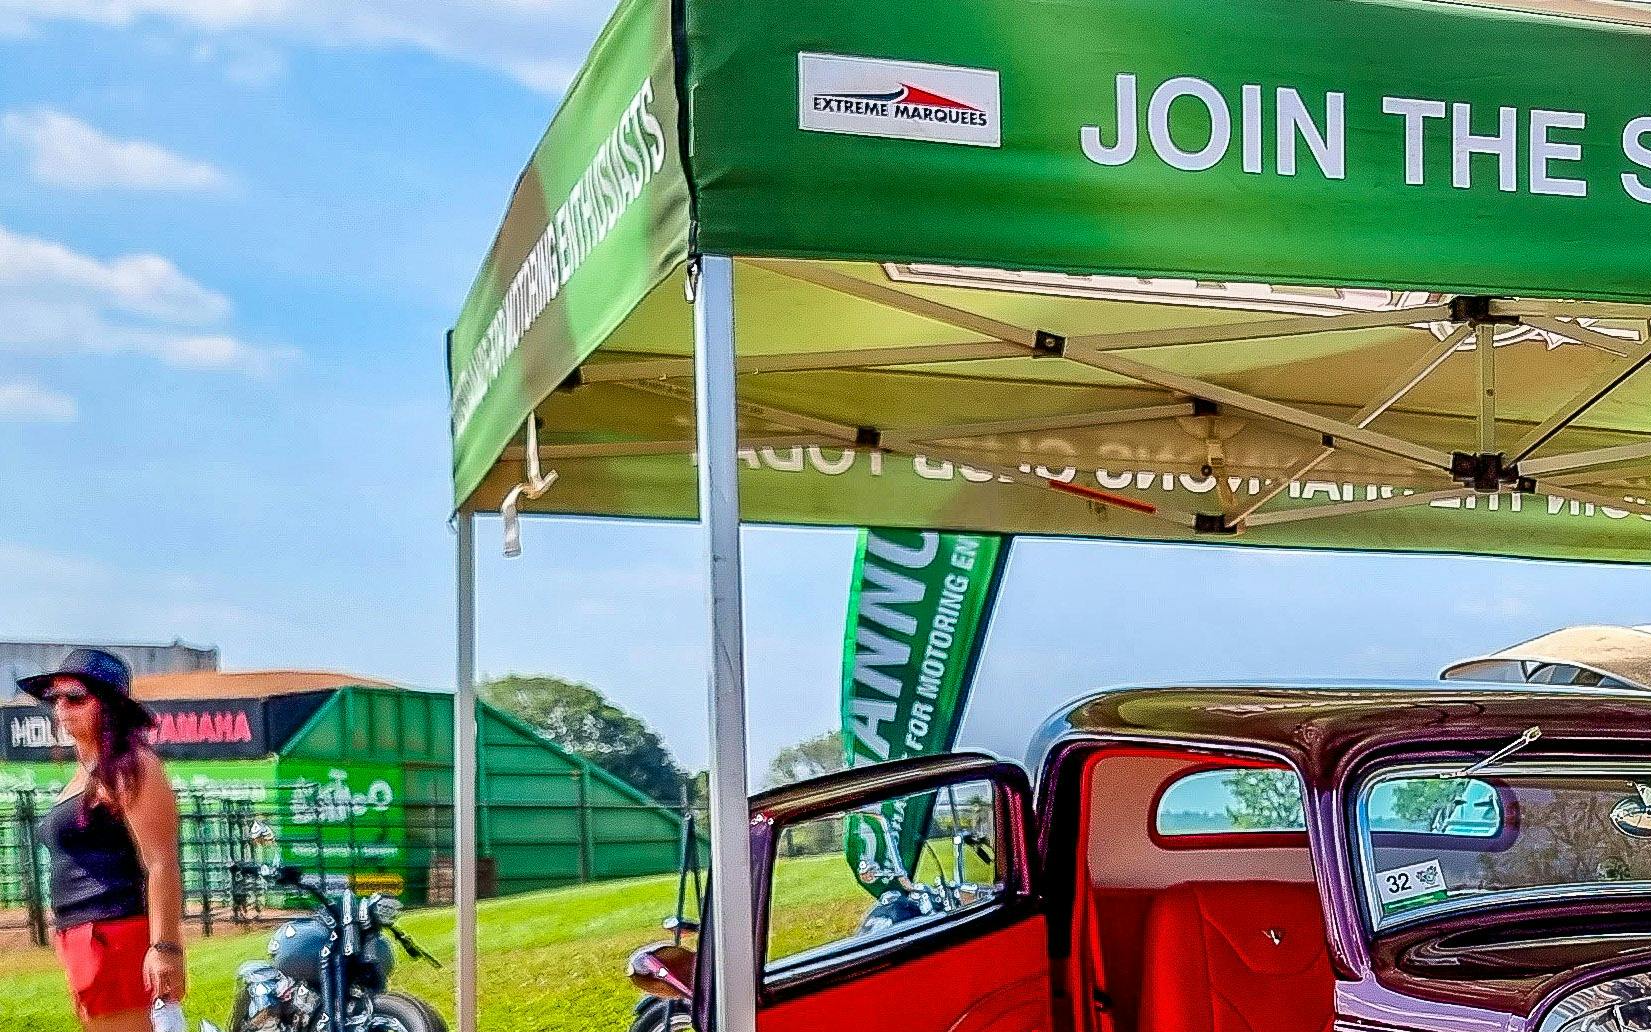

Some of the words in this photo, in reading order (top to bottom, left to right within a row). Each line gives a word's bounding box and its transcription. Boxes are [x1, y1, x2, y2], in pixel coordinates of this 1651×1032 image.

[813, 96, 889, 118] EXTREME
[893, 103, 988, 128] MARQUEES
[1079, 72, 1346, 181] JOIN
[1381, 96, 1588, 198] THE
[549, 76, 666, 286] ENTHUSIASTS
[915, 572, 970, 704] MOTORING
[904, 702, 935, 751] FOR
[1386, 872, 1412, 893] 32
